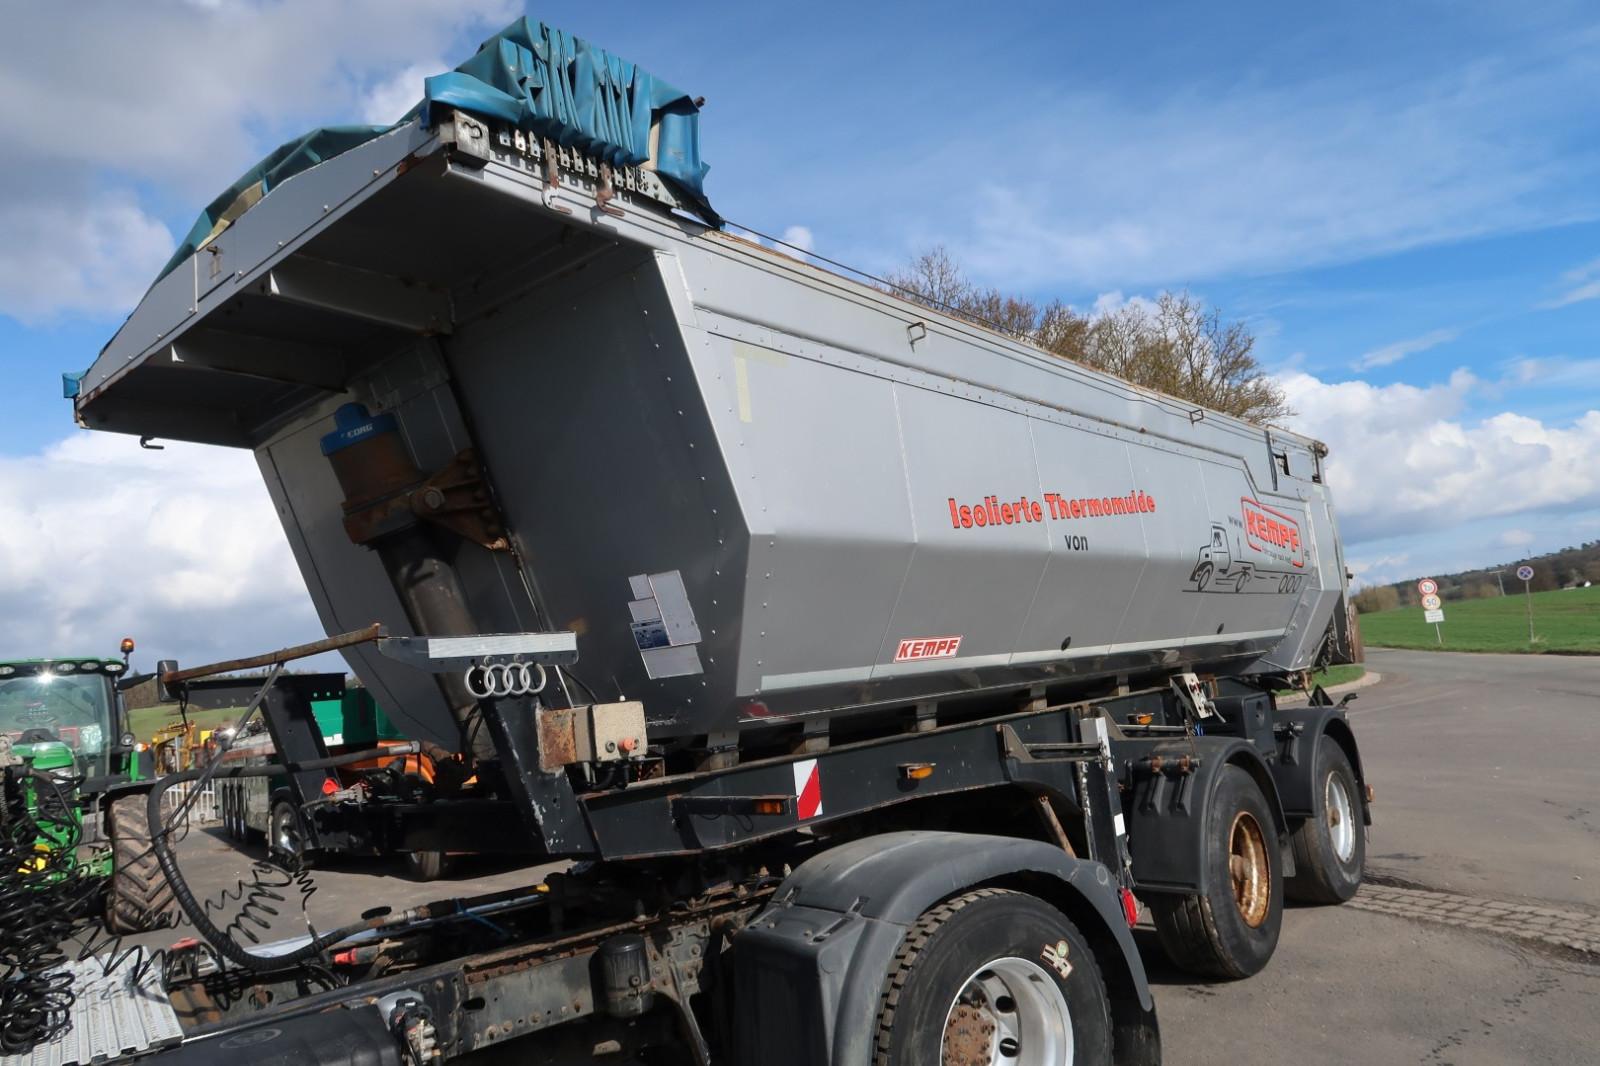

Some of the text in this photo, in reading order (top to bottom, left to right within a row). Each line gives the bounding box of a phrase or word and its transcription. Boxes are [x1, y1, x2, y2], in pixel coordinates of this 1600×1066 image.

[948, 490, 1156, 529] Isolierte Thermomulde
[1064, 534, 1088, 551] von
[1246, 508, 1299, 552] KEMPF
[898, 639, 959, 658] KEMPF
